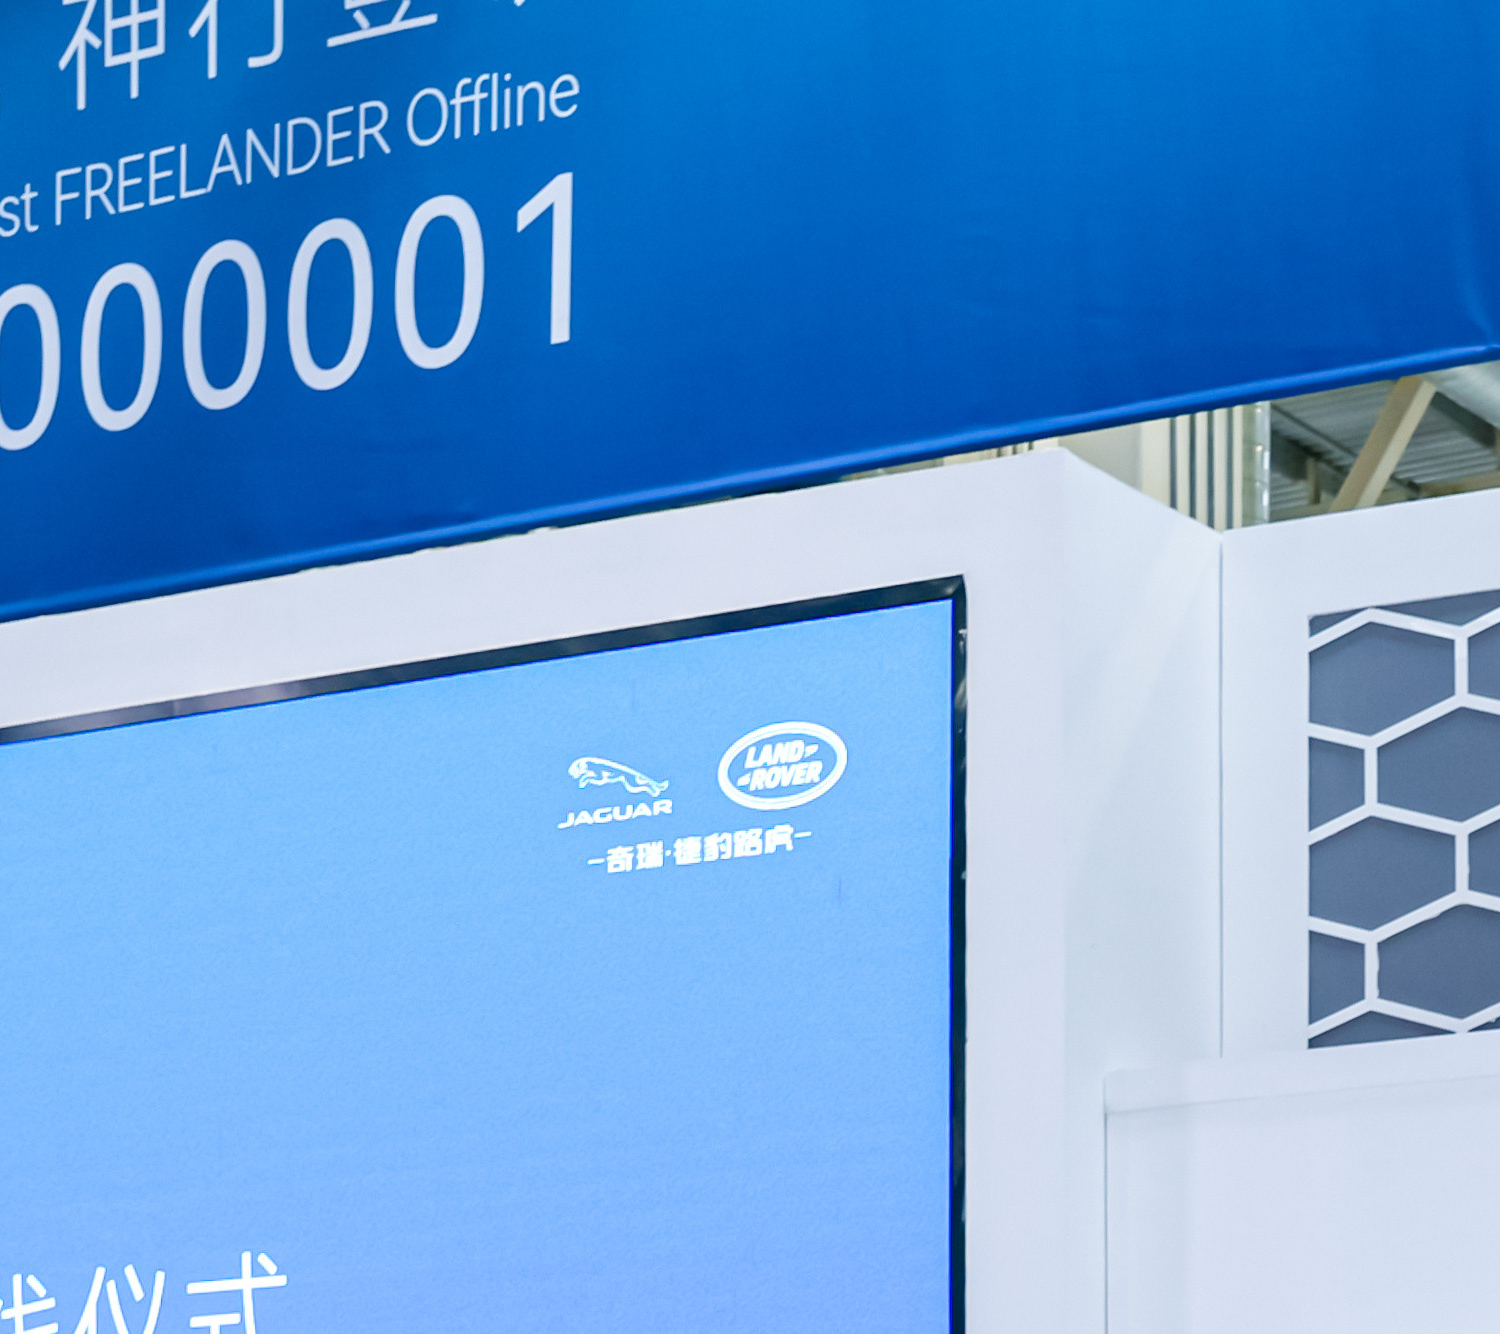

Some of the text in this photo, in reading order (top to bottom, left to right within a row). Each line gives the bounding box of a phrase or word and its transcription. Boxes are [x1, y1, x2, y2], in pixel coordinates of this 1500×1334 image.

[55, 100, 391, 226] FREELANDER
[406, 72, 580, 147] Offline
[743, 740, 805, 769] LAND
[749, 761, 823, 791] ROVER
[557, 799, 673, 829] JAGUAR
